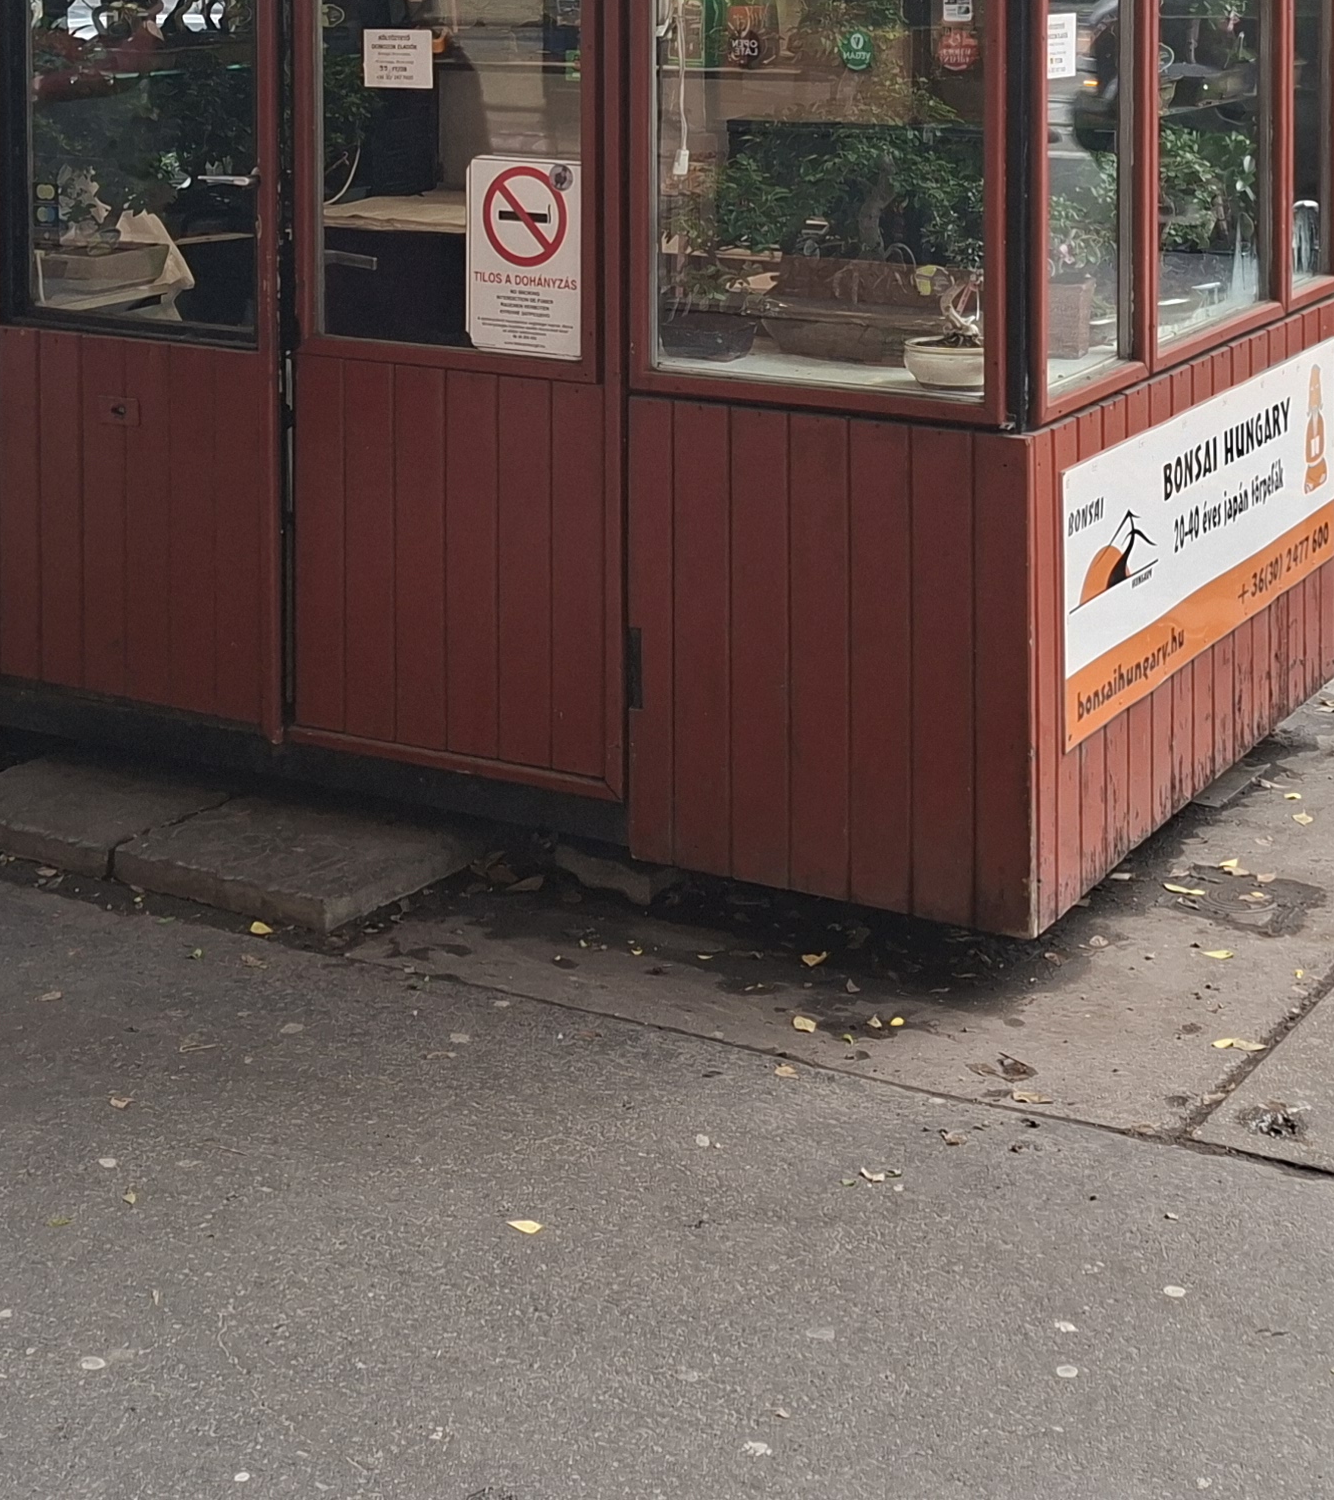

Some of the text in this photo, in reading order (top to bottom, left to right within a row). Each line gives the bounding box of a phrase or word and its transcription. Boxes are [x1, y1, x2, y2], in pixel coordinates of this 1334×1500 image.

[474, 271, 578, 291] TILOS A DOHÁNYZÁS
[1163, 396, 1291, 501] BONSAI HUNGARY
[1068, 497, 1104, 537] BONSAI
[1174, 458, 1283, 553] 20-40 éves japán törpefák
[1286, 534, 1310, 572] 2477
[1312, 522, 1329, 553] 600
[1077, 627, 1185, 722] bonsaihungary.hu
